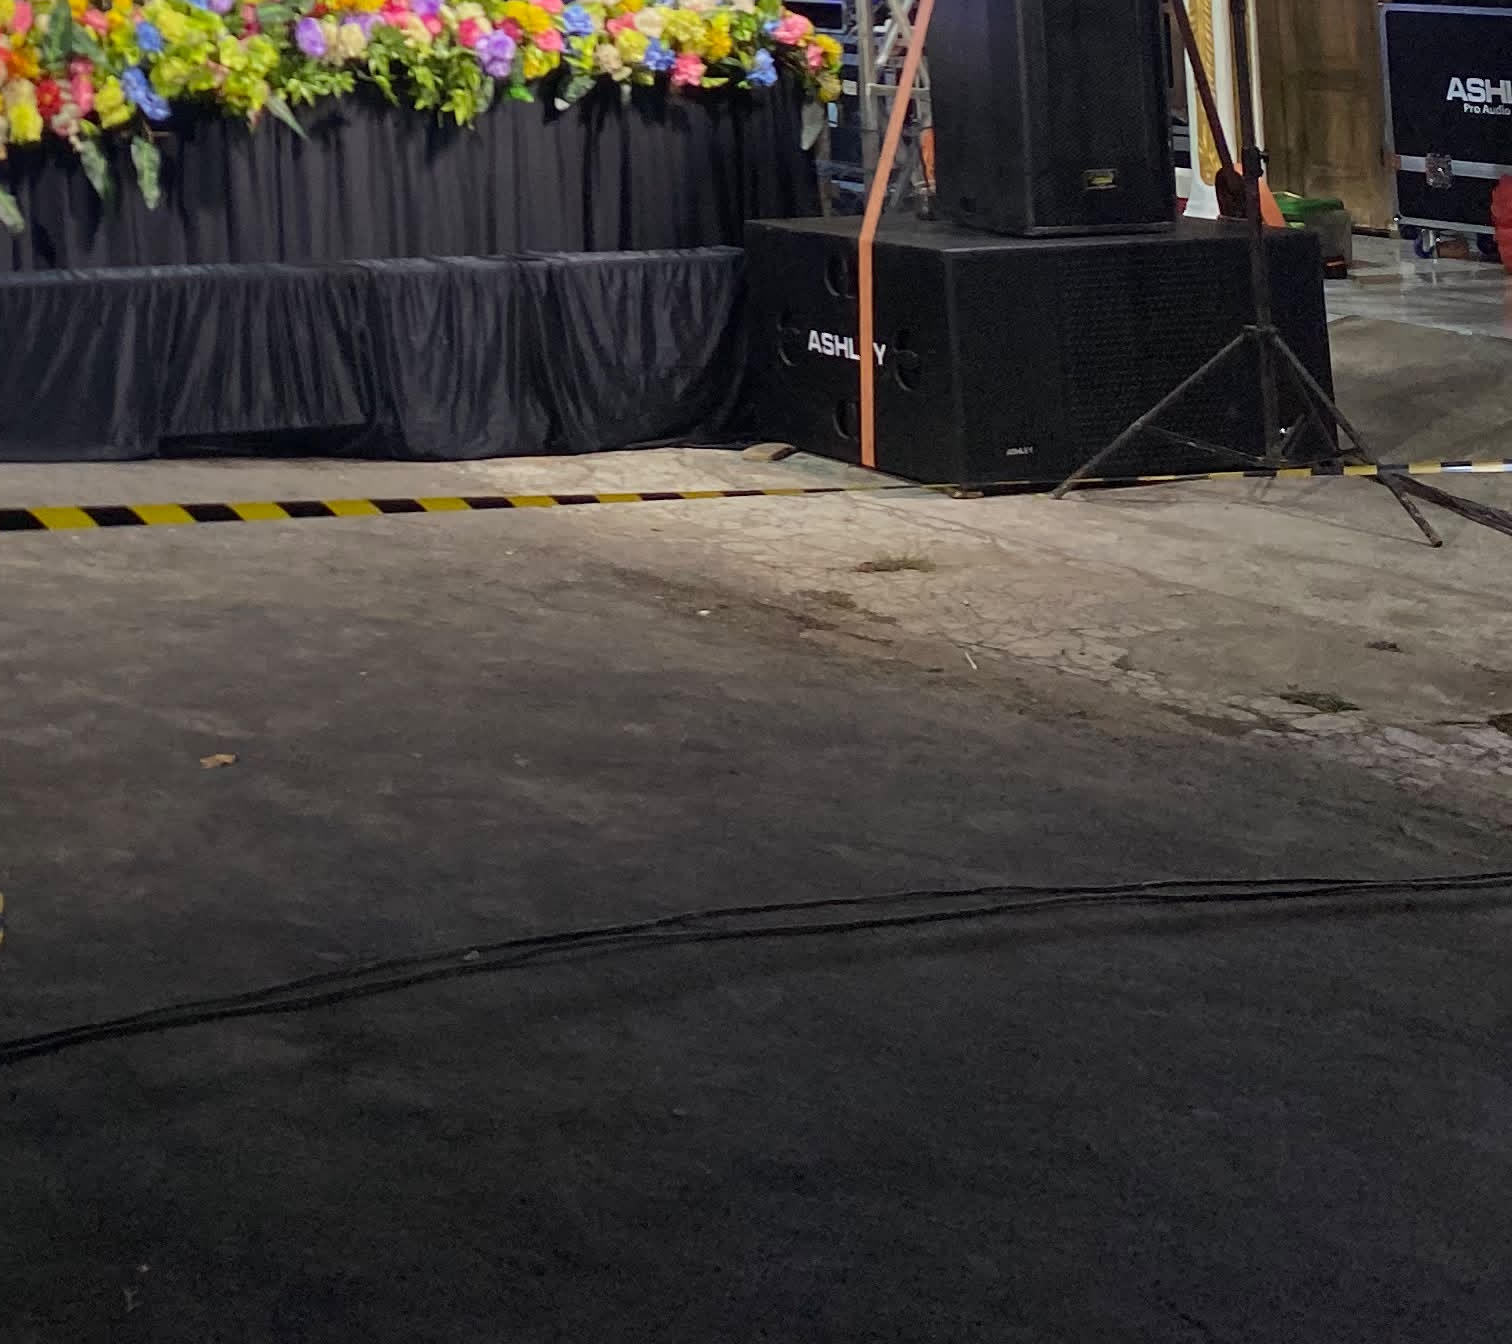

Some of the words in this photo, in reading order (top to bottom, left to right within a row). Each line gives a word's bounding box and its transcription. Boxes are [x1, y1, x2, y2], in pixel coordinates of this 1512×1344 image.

[1463, 102, 1481, 113] Pro
[1482, 104, 1511, 115] Audio
[807, 329, 887, 366] ASHLY
